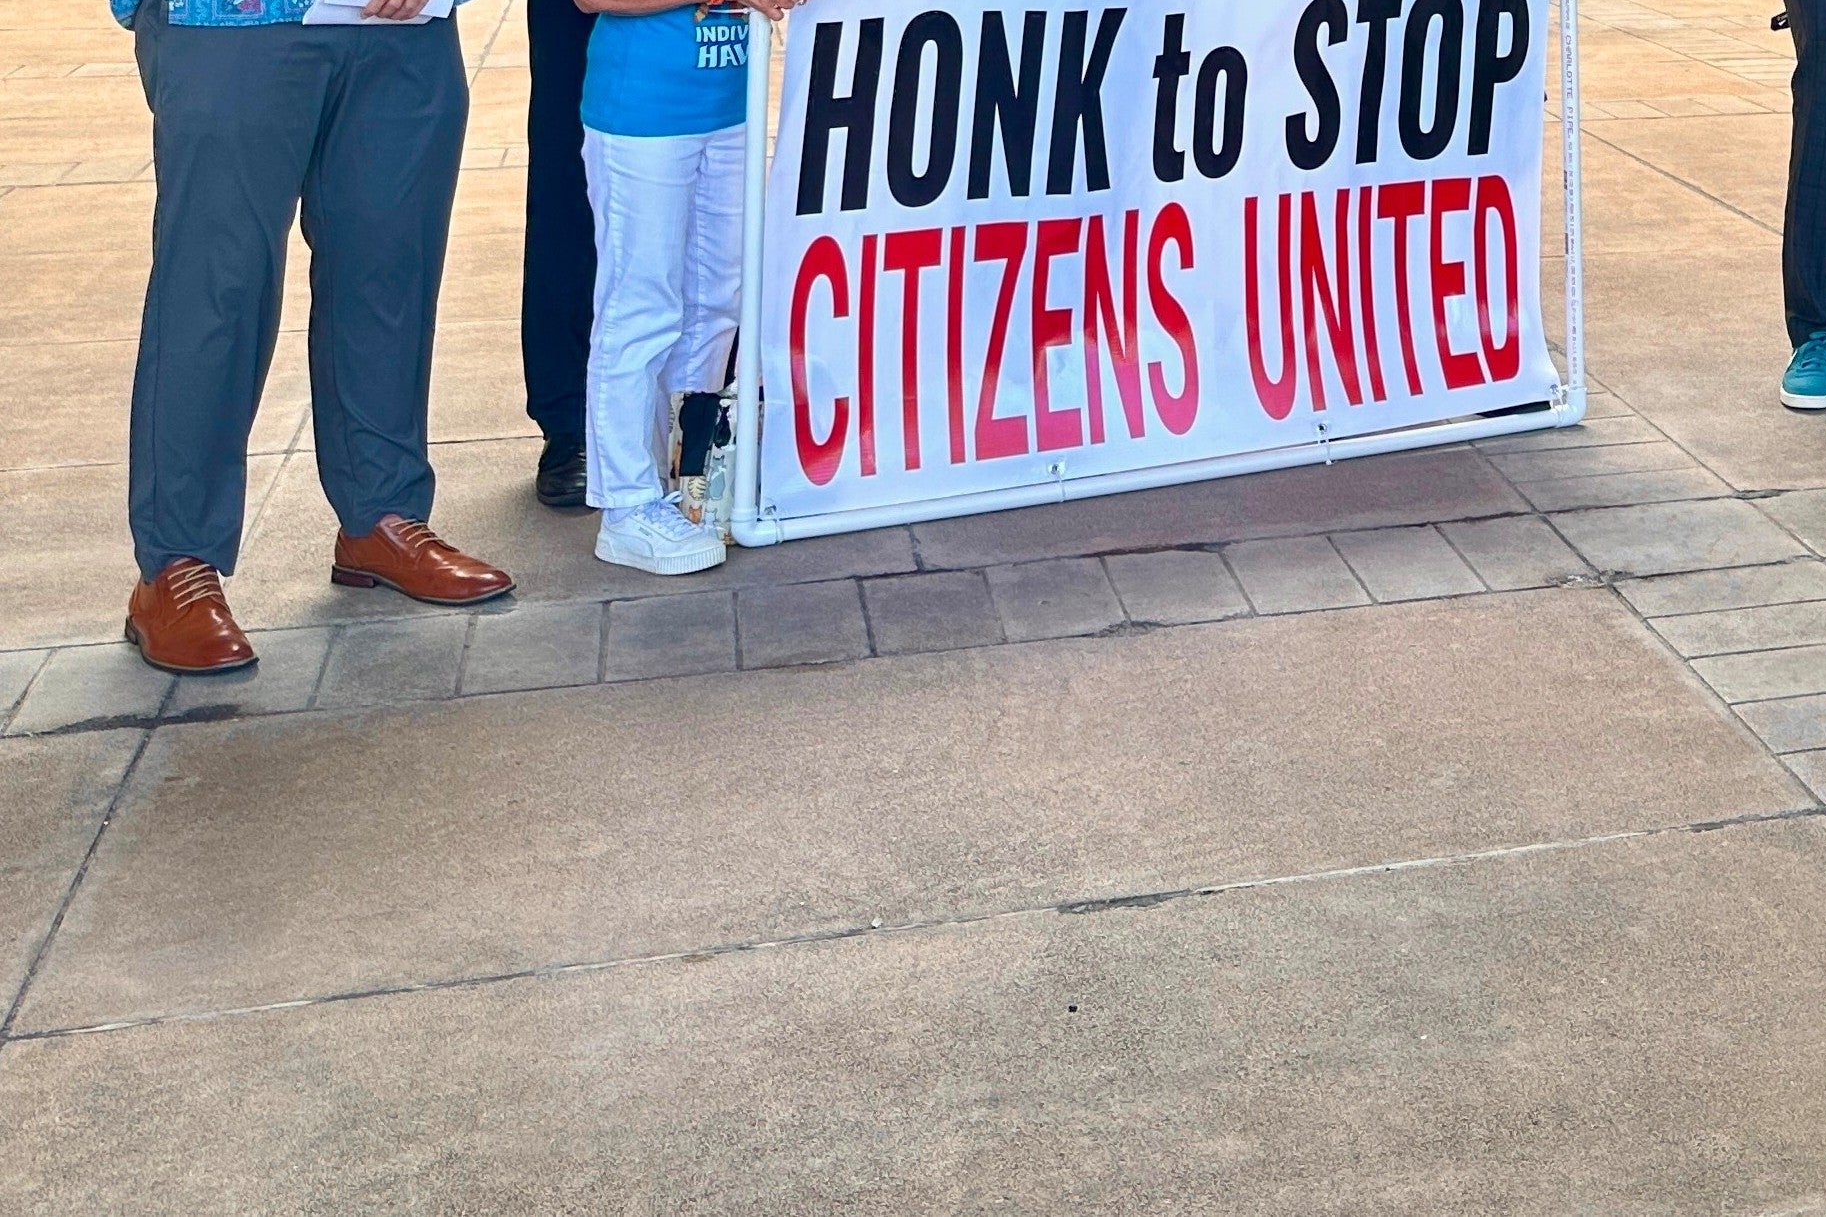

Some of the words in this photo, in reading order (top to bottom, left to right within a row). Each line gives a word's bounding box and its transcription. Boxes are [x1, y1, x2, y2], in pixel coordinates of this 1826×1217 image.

[795, 6, 1128, 216] HONK
[1151, 12, 1249, 183] to
[788, 201, 1199, 487] CITIZENS
[1243, 174, 1521, 421] UNITED
